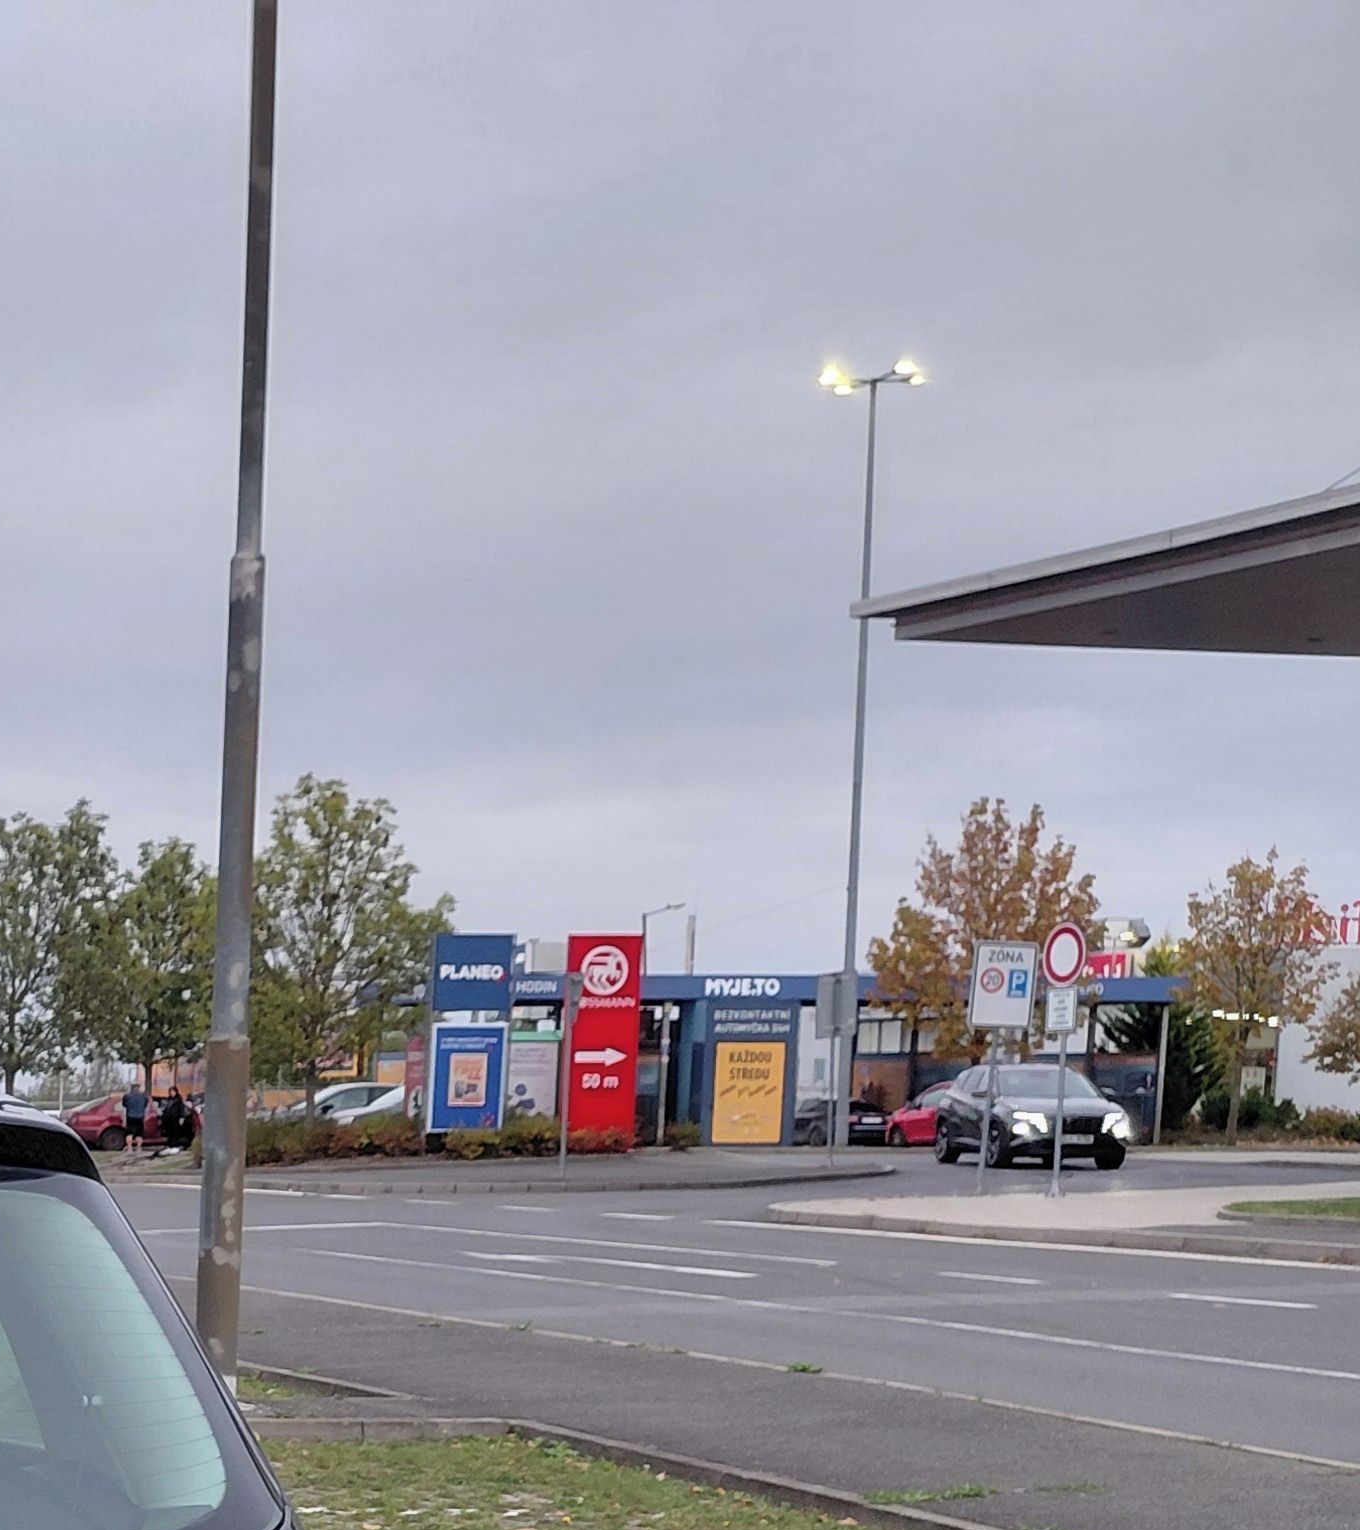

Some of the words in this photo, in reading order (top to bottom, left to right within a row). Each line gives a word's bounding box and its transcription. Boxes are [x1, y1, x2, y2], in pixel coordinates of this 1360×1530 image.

[988, 950, 1025, 964] ZÓNA
[439, 964, 504, 981] PLANEO
[986, 972, 1000, 987] 20
